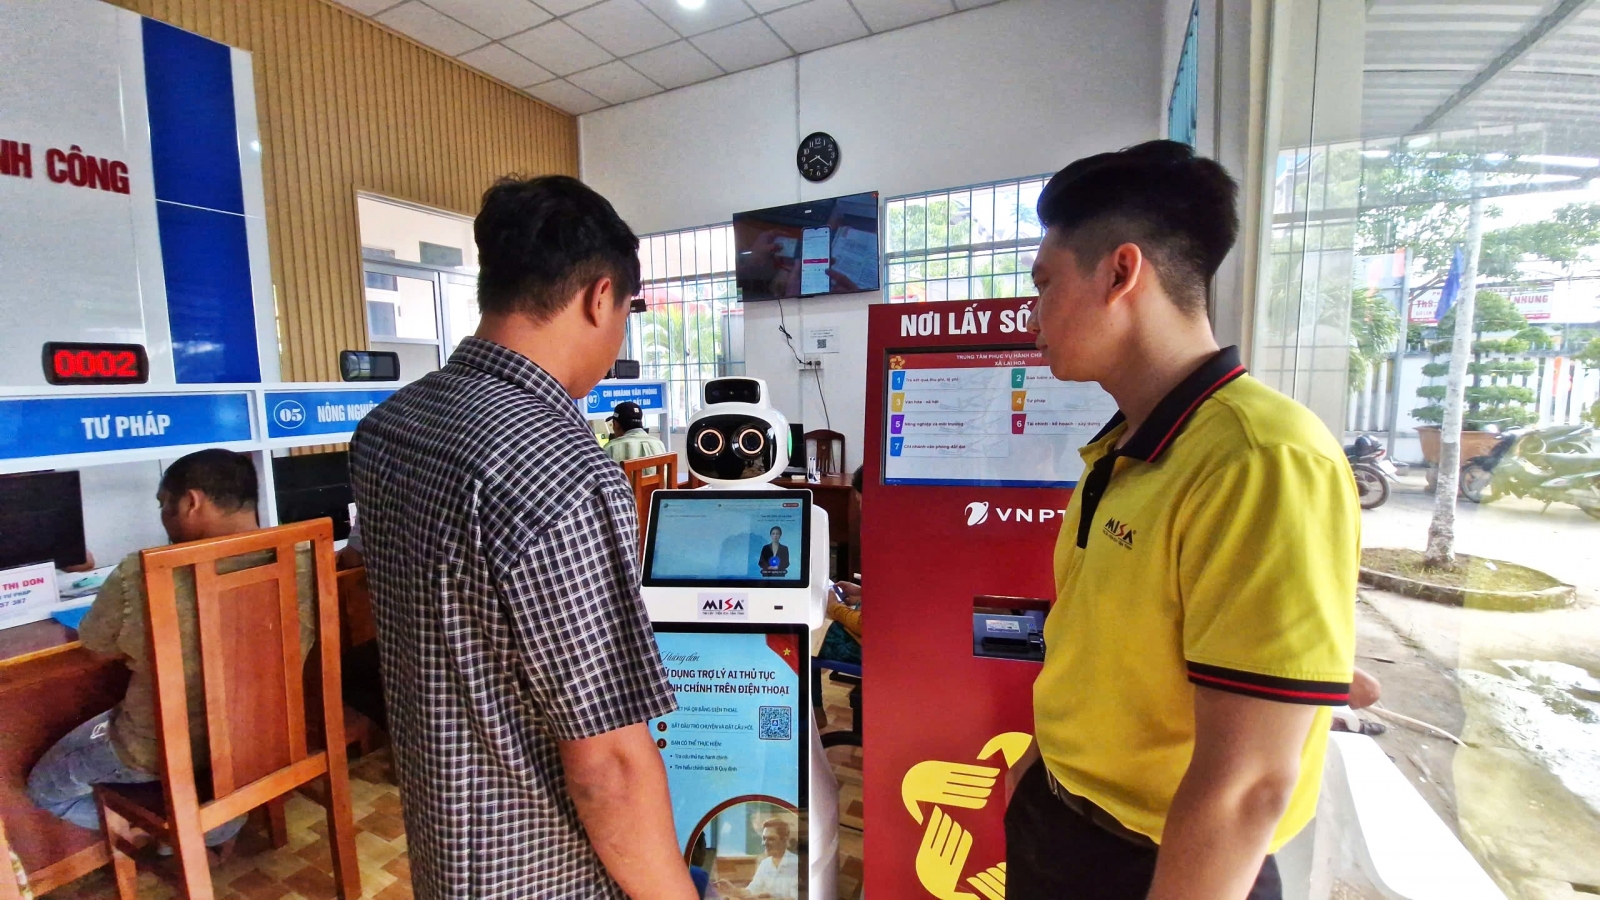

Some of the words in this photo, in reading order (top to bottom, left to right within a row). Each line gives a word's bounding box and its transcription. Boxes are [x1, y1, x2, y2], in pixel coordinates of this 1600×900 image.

[46, 144, 130, 195] CÔNG
[1513, 295, 1549, 304] NHUNG
[900, 311, 940, 337] NƠI
[948, 303, 991, 335] LẤY
[1000, 300, 1033, 333] SỐ
[54, 349, 138, 378] 0002
[588, 394, 597, 404] 07
[602, 389, 612, 398] CHI
[280, 408, 302, 422] 05
[317, 402, 346, 423] NÔNG
[80, 414, 111, 440] TƯ
[115, 410, 171, 438] PHÁP
[1105, 517, 1133, 545] MISA
[702, 598, 744, 611] MISA
[671, 670, 695, 680] DỤNG
[697, 670, 714, 680] TRỢ
[716, 668, 726, 679] LÝ
[727, 671, 737, 679] AI
[740, 668, 756, 679] THỦ
[758, 671, 775, 681] TỤC
[684, 682, 712, 693] CHÍNH
[714, 682, 736, 694] TRÊN
[738, 682, 760, 696] ĐIỆN
[762, 686, 789, 696] THOẠI
